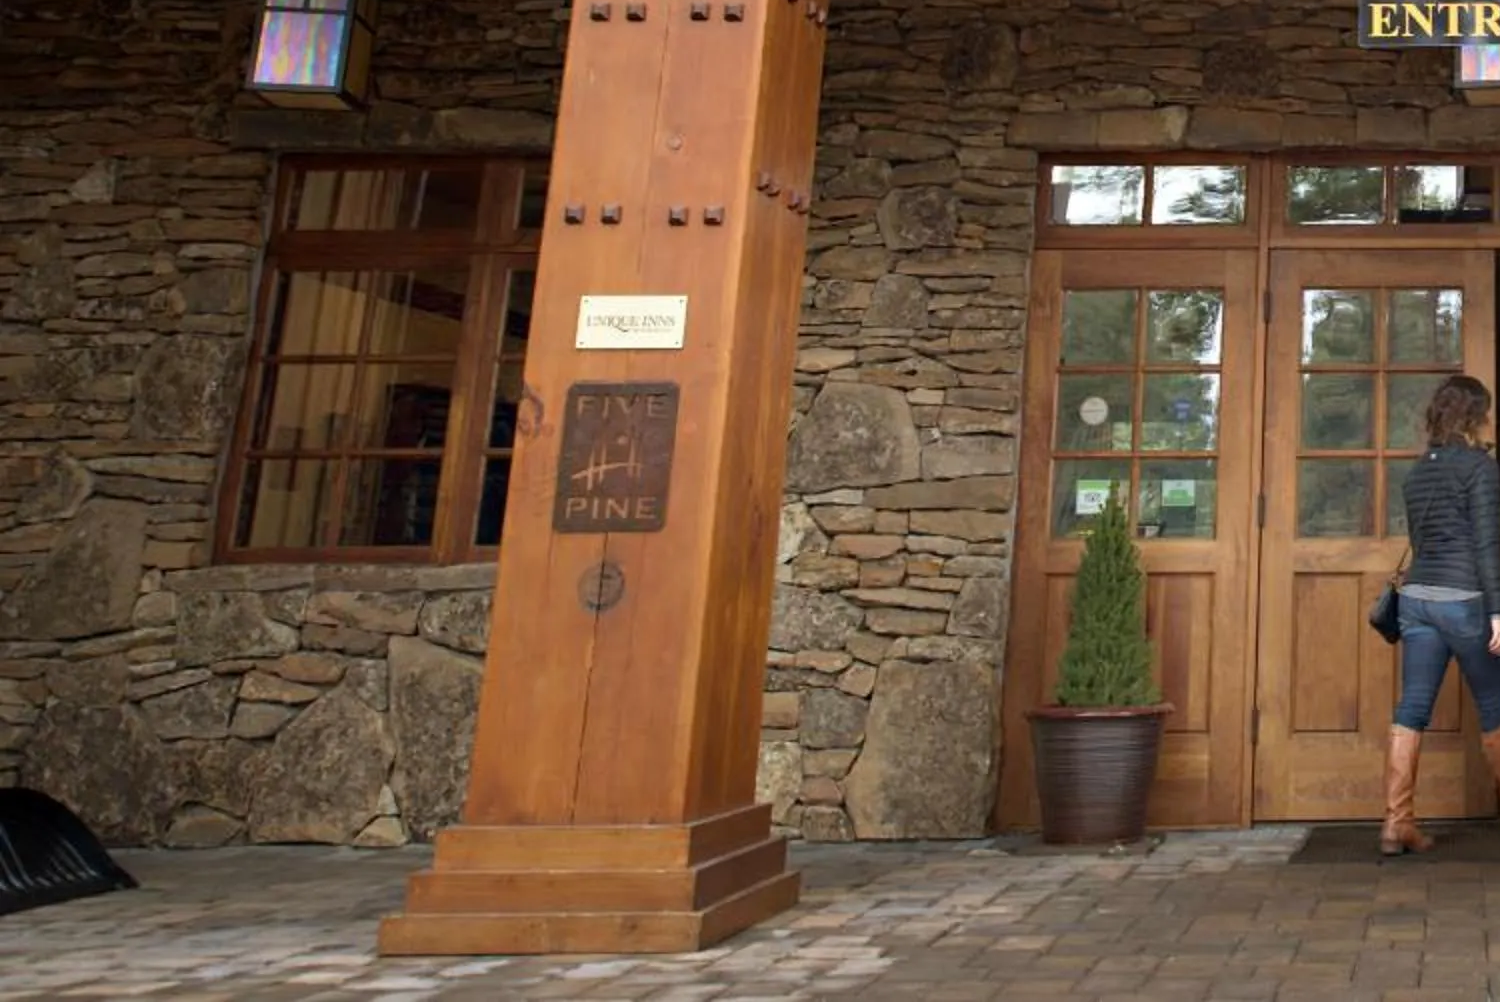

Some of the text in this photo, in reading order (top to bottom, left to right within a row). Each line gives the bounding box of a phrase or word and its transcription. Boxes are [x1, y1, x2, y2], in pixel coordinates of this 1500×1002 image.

[641, 314, 676, 327] INNS
[576, 395, 669, 419] FIVE
[565, 496, 657, 520] PINE
